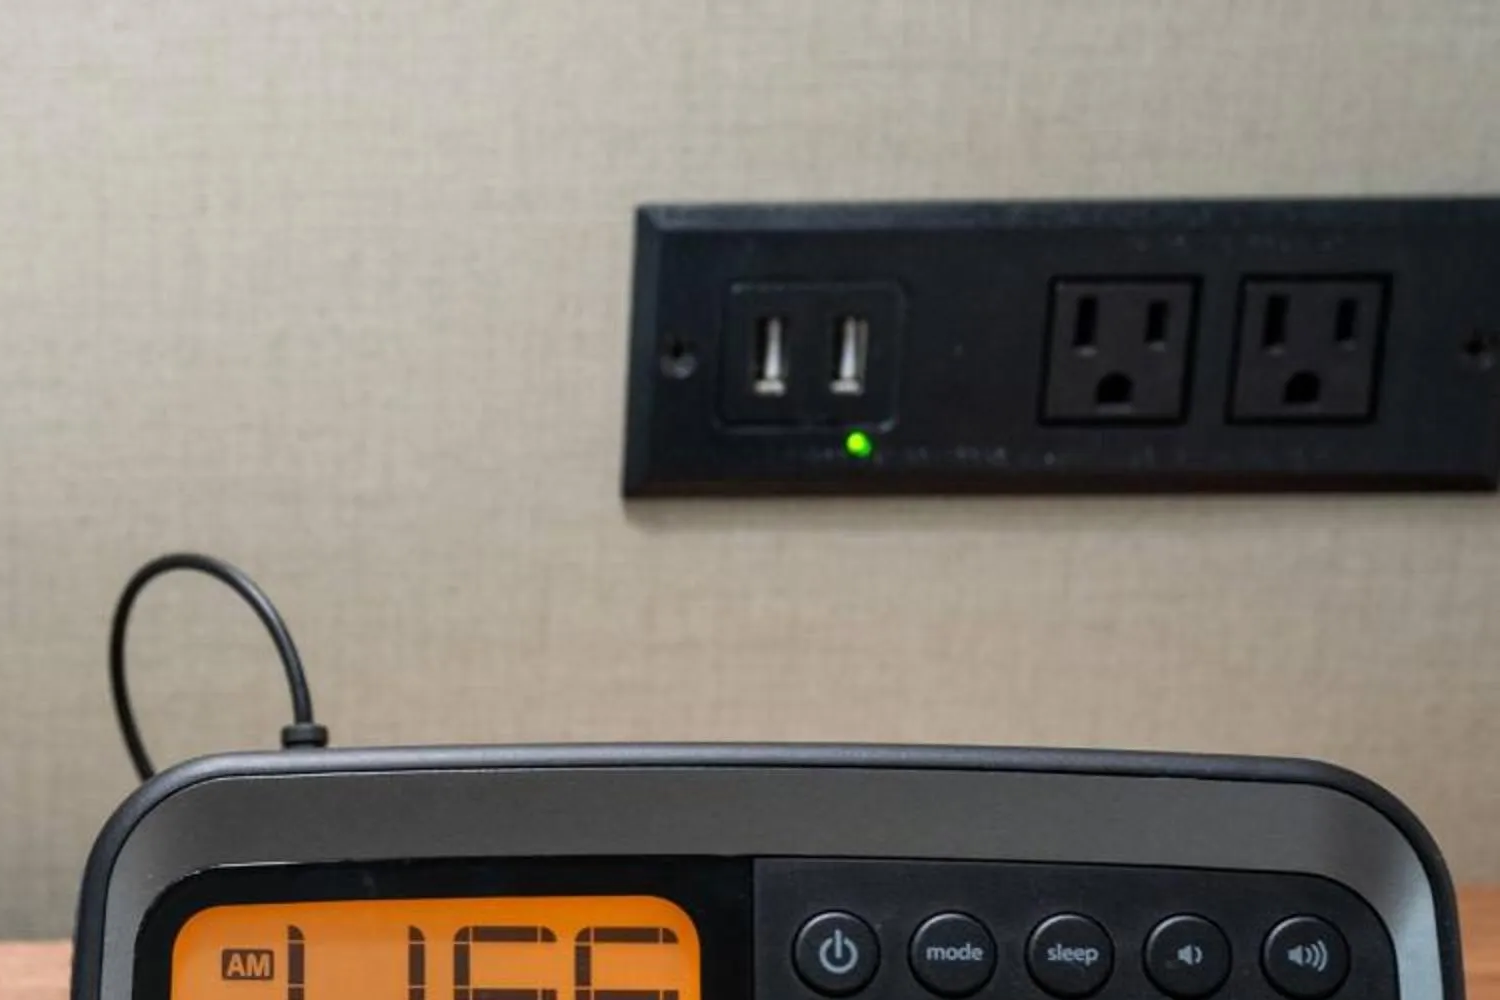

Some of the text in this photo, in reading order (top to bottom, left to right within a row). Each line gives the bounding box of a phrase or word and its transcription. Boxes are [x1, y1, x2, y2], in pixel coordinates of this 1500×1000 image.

[925, 943, 984, 962] mode
[1047, 943, 1099, 967] sleep
[226, 952, 272, 979] AM
